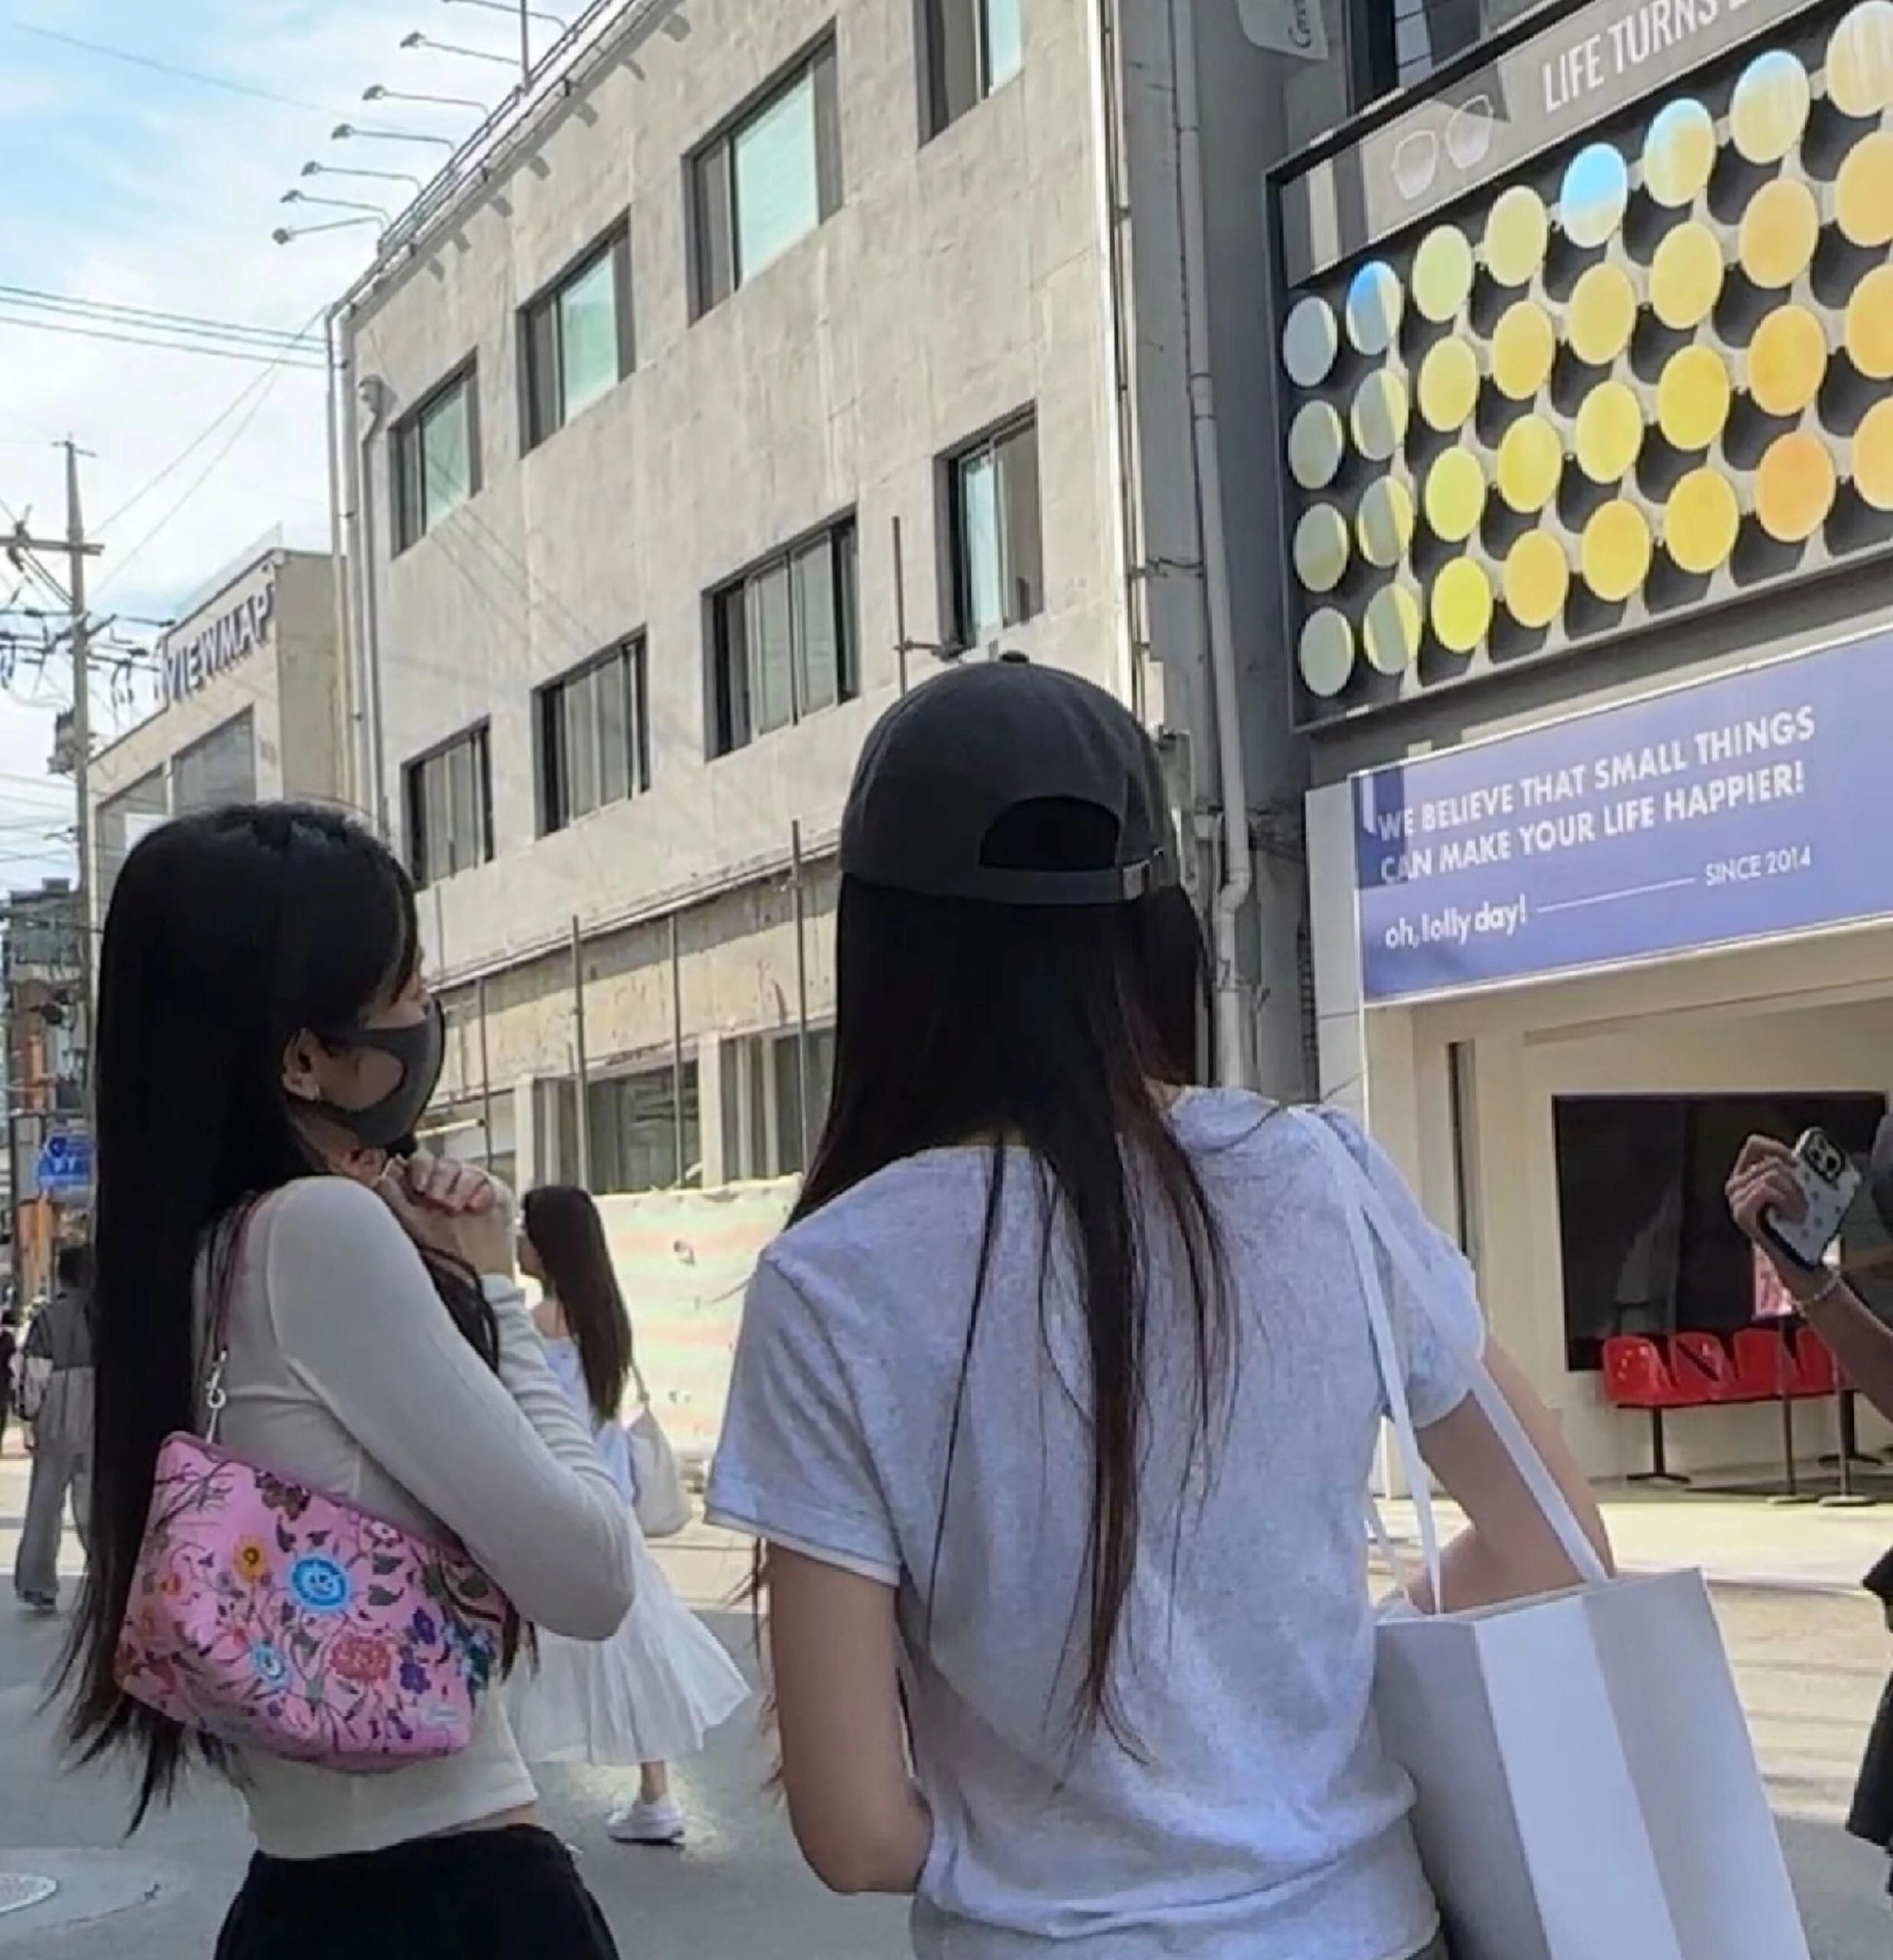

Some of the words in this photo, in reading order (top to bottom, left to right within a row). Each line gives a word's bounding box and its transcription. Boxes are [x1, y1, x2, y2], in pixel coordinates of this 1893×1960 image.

[1543, 34, 1605, 113] LIFE
[1378, 808, 1413, 842] WE
[1422, 784, 1513, 831] BELIEVE
[1521, 764, 1586, 807] THAT
[1594, 740, 1688, 790] SMALL
[1694, 705, 1815, 765] THINGS
[1381, 848, 1433, 884] CAN
[1439, 832, 1512, 873] MAKE
[1521, 811, 1595, 856] YOUR
[1604, 796, 1655, 836] LIFE
[1665, 760, 1805, 822] HAPPIER!
[1706, 854, 1762, 886] SINCE
[1767, 845, 1811, 873] 2014
[1475, 892, 1527, 936] day!
